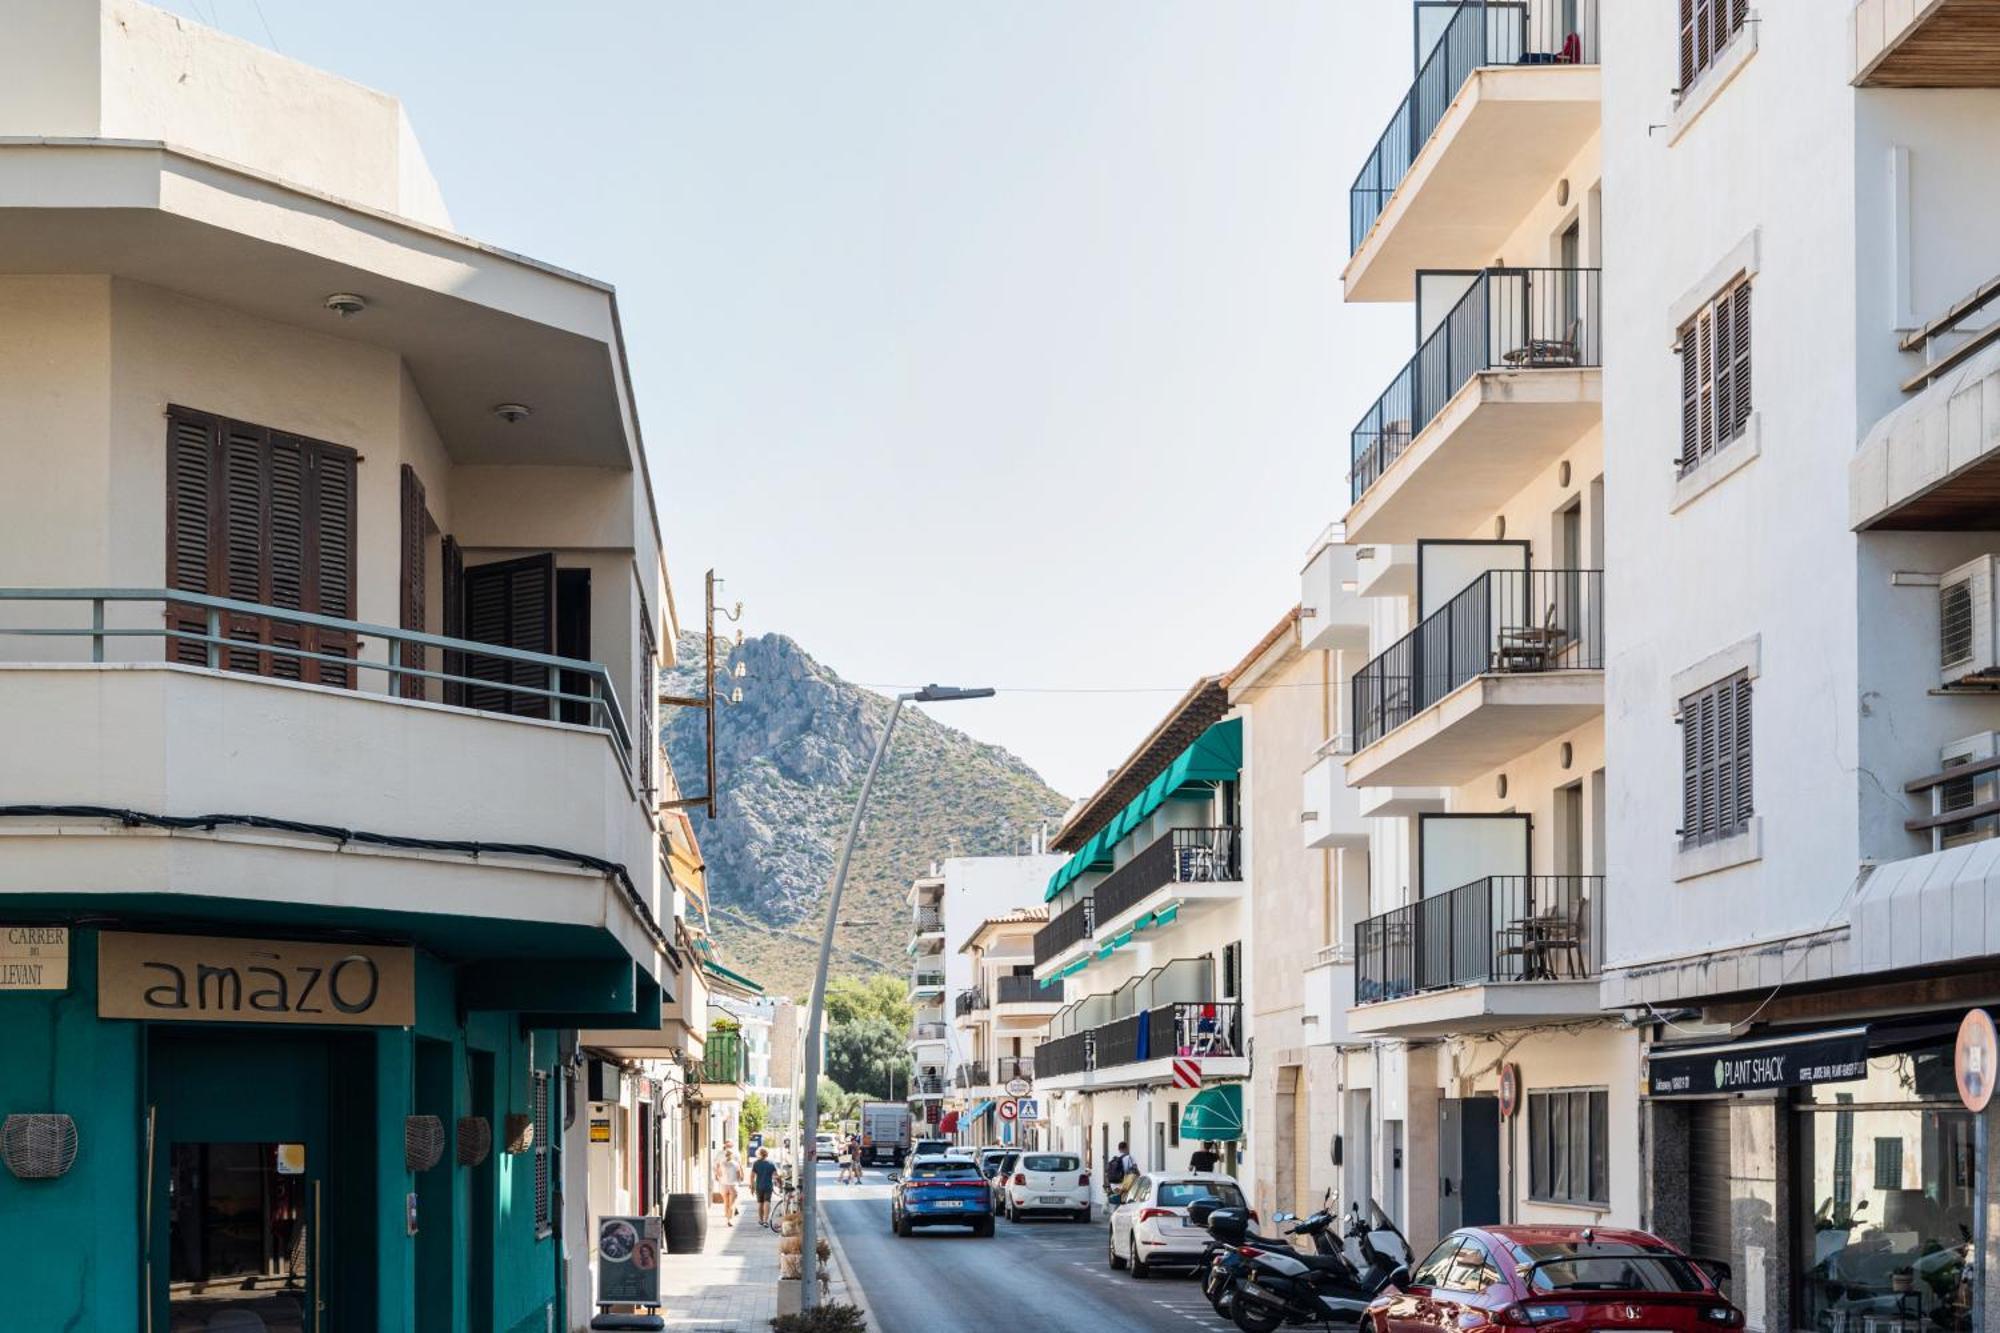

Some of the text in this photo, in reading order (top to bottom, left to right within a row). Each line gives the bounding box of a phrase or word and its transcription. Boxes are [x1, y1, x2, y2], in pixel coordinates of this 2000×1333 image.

[8, 928, 64, 945] CARRER
[1724, 1056, 1784, 1085] PLANT SHACK
